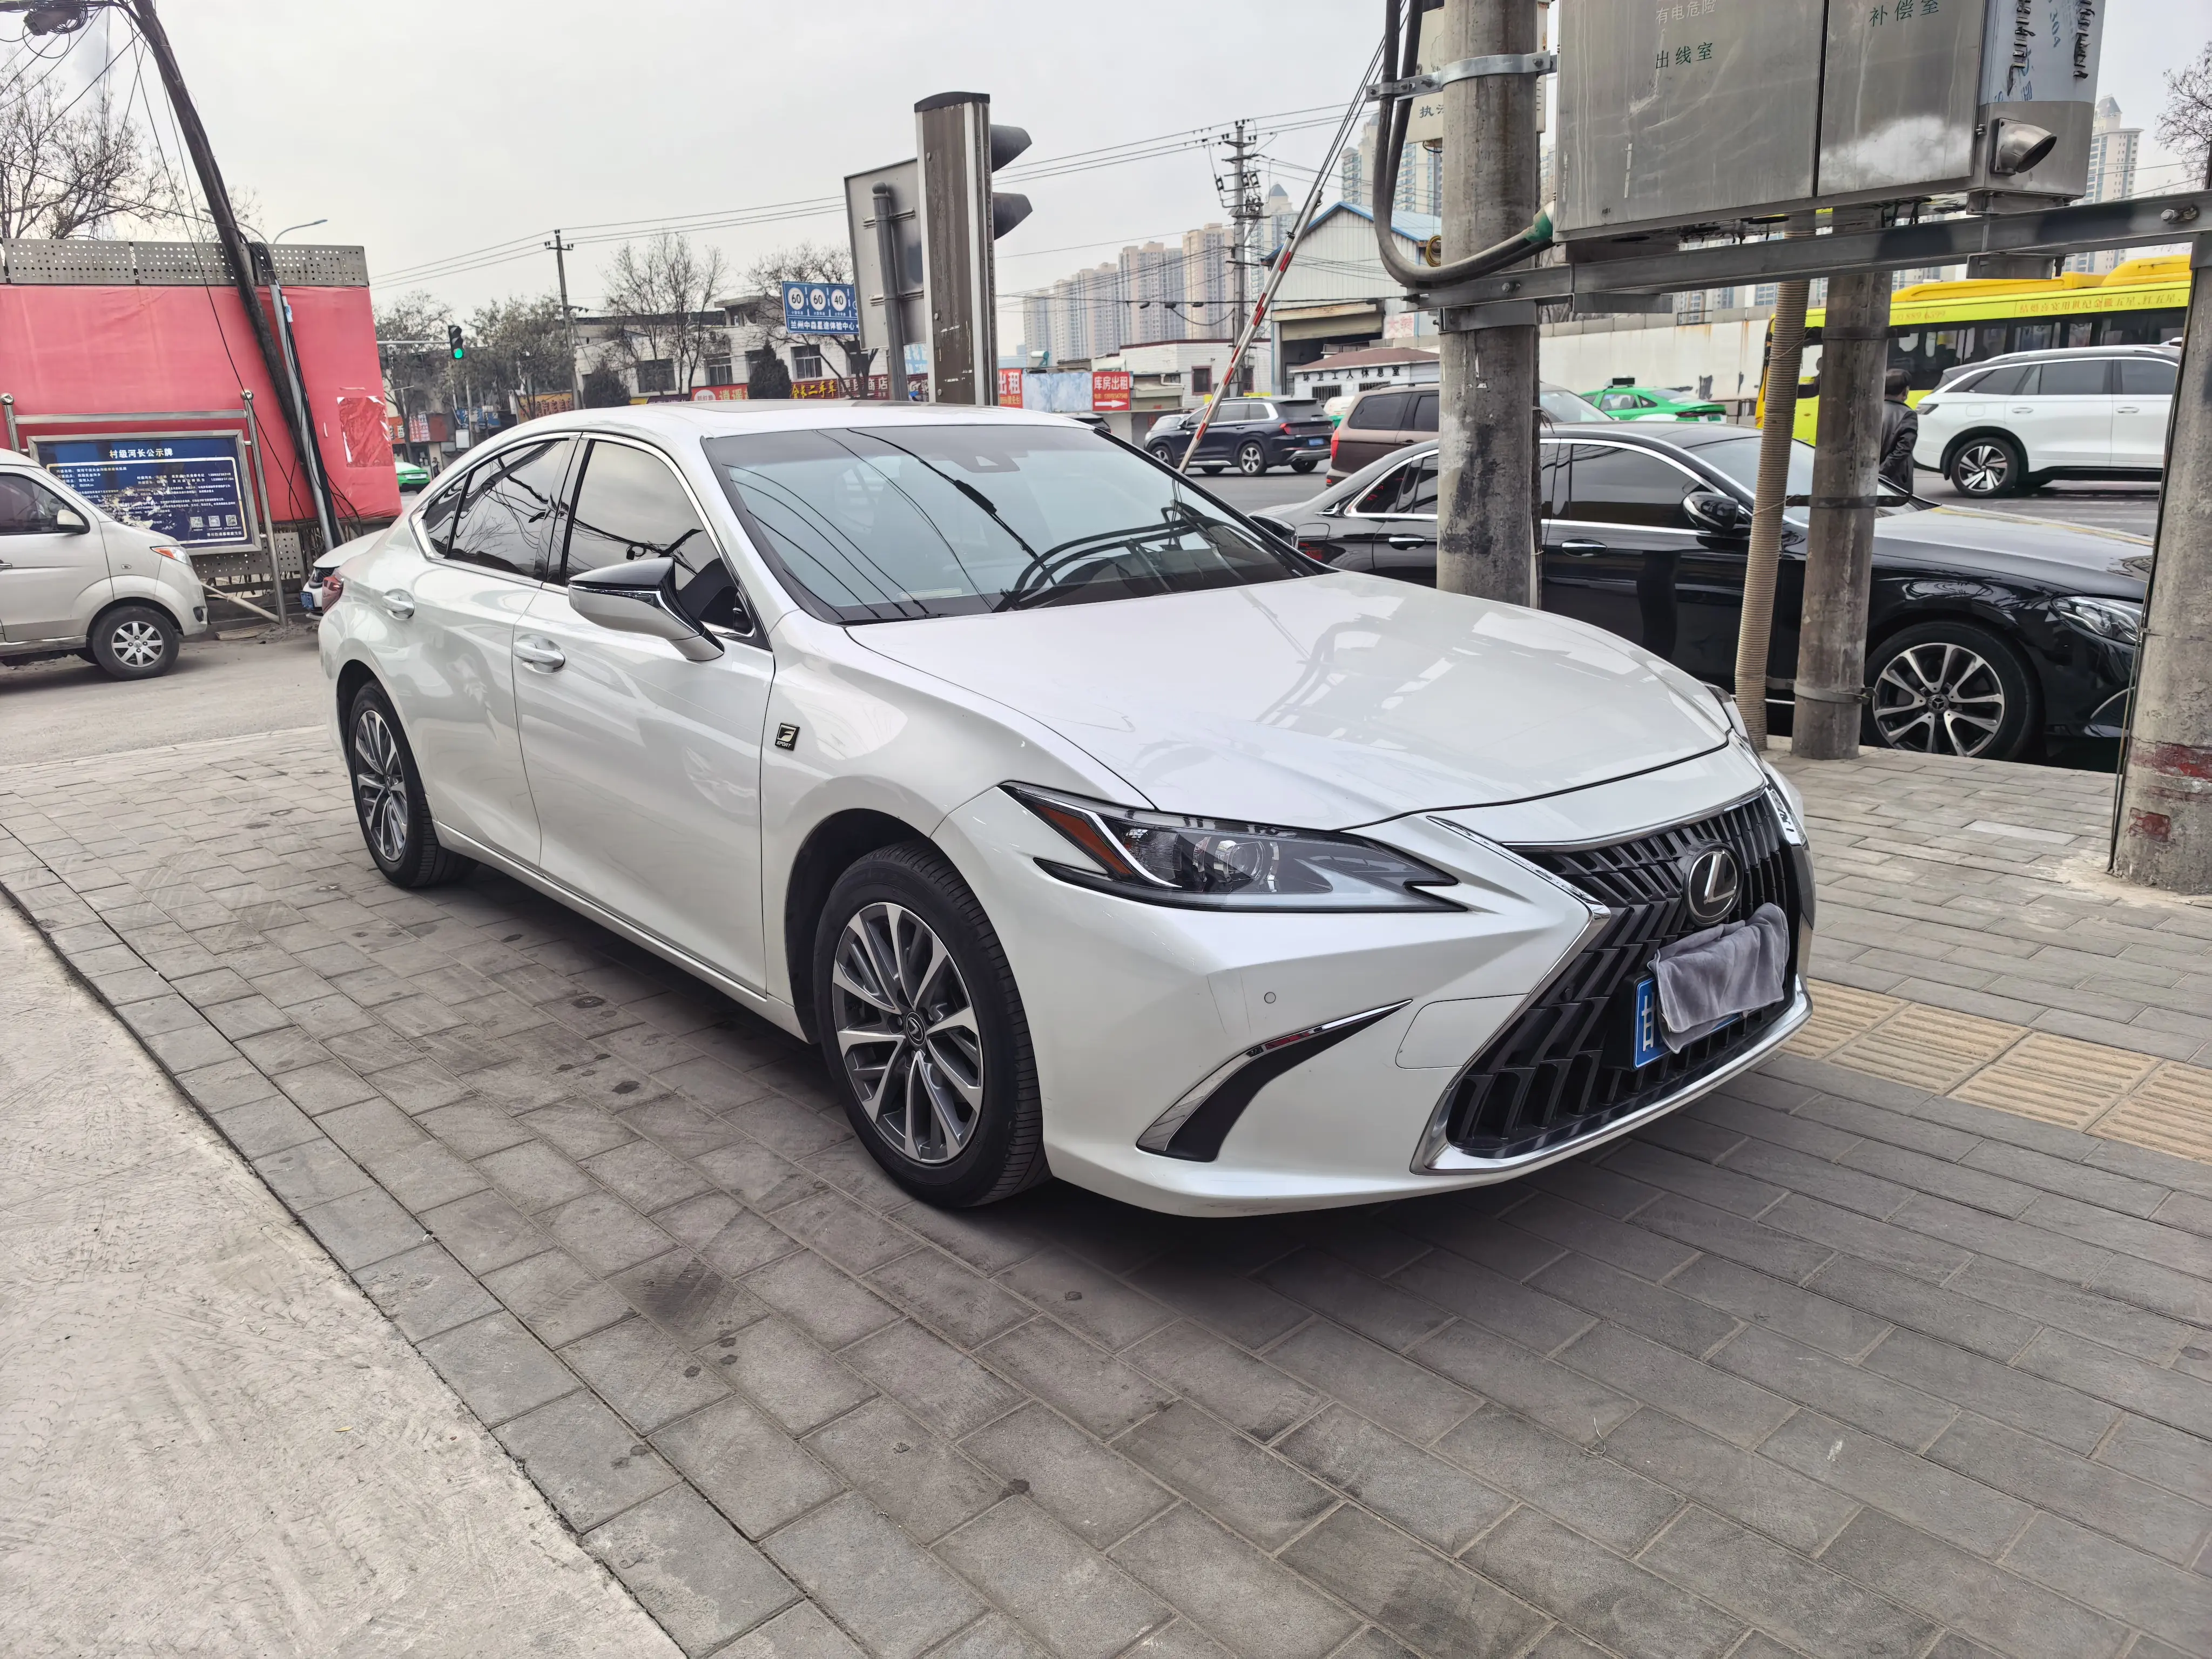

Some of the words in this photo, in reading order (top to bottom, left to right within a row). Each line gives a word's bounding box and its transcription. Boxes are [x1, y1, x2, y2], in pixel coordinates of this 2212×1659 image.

[1655, 0, 1716, 25] 有电危险
[1869, 0, 1939, 27] 补偿室
[1655, 42, 1712, 69] 出线室
[792, 294, 801, 304] 60
[813, 294, 823, 305] 60
[834, 295, 844, 305] 40
[1303, 366, 1400, 382] 环卫工人休息室
[1094, 375, 1128, 390] 库房出租
[719, 389, 749, 400] 逍遥
[109, 448, 173, 458] 村级河长公示牌
